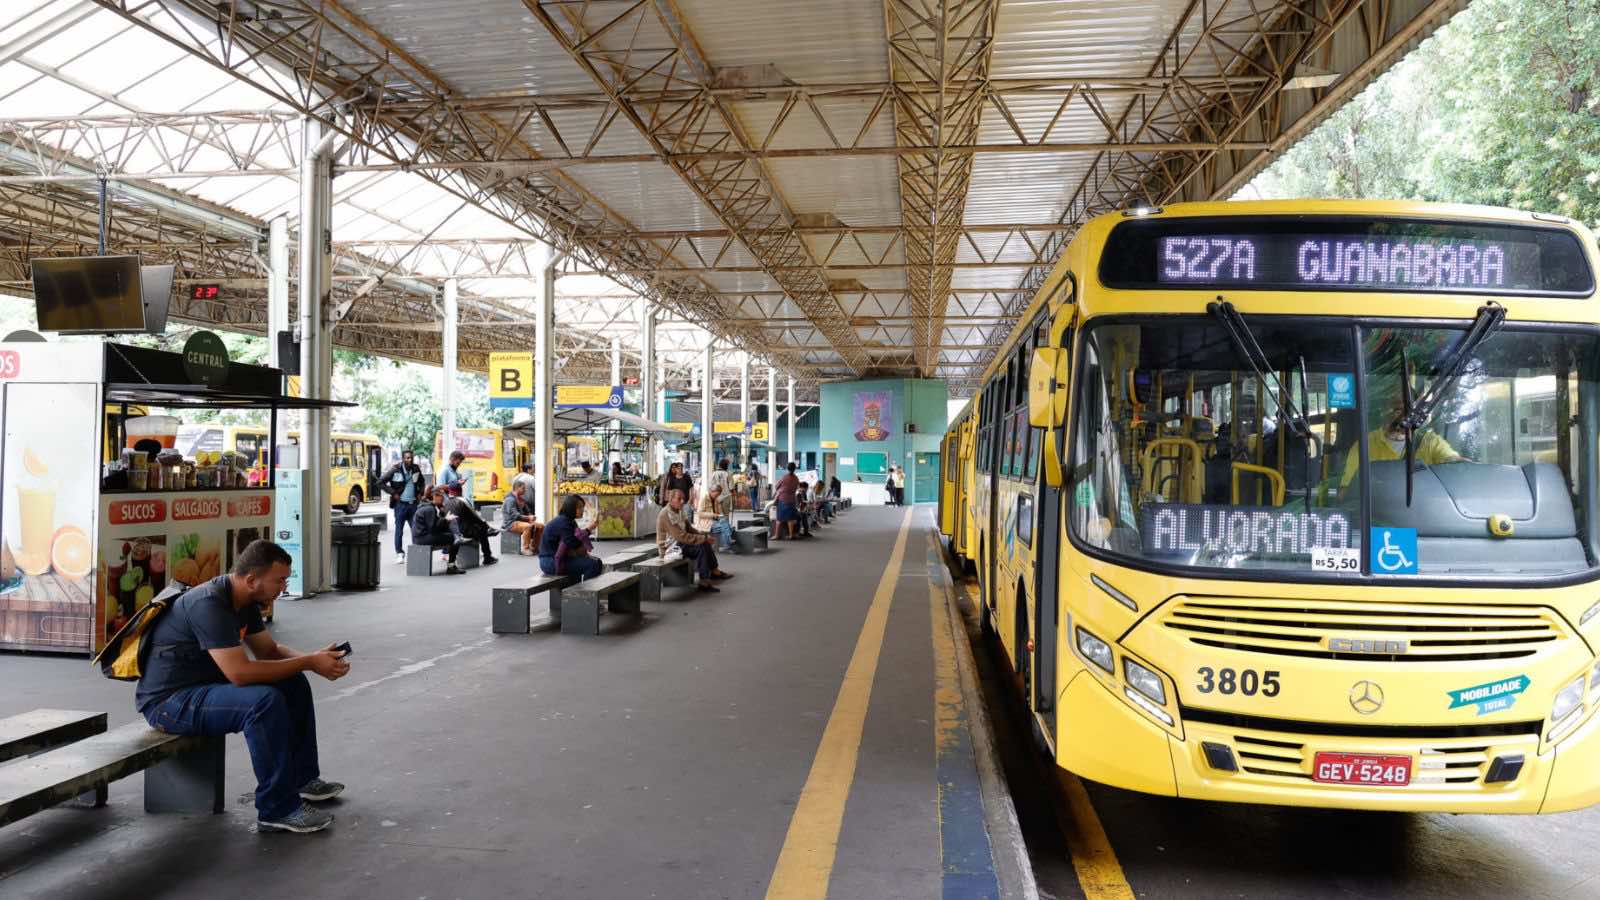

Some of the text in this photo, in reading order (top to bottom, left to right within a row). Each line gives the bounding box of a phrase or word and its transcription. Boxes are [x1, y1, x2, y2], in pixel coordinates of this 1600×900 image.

[1164, 238, 1504, 285] 527A GUANABARA
[188, 351, 224, 368] CENTRAL
[501, 368, 521, 392] B
[754, 428, 764, 439] B
[121, 503, 156, 520] SUCOS
[175, 500, 220, 517] SALGADOS
[1154, 509, 1348, 553] ALVORADA
[1196, 667, 1280, 697] 3805
[1460, 679, 1522, 702] MOBILIDADE
[1484, 699, 1507, 712] TOTAL
